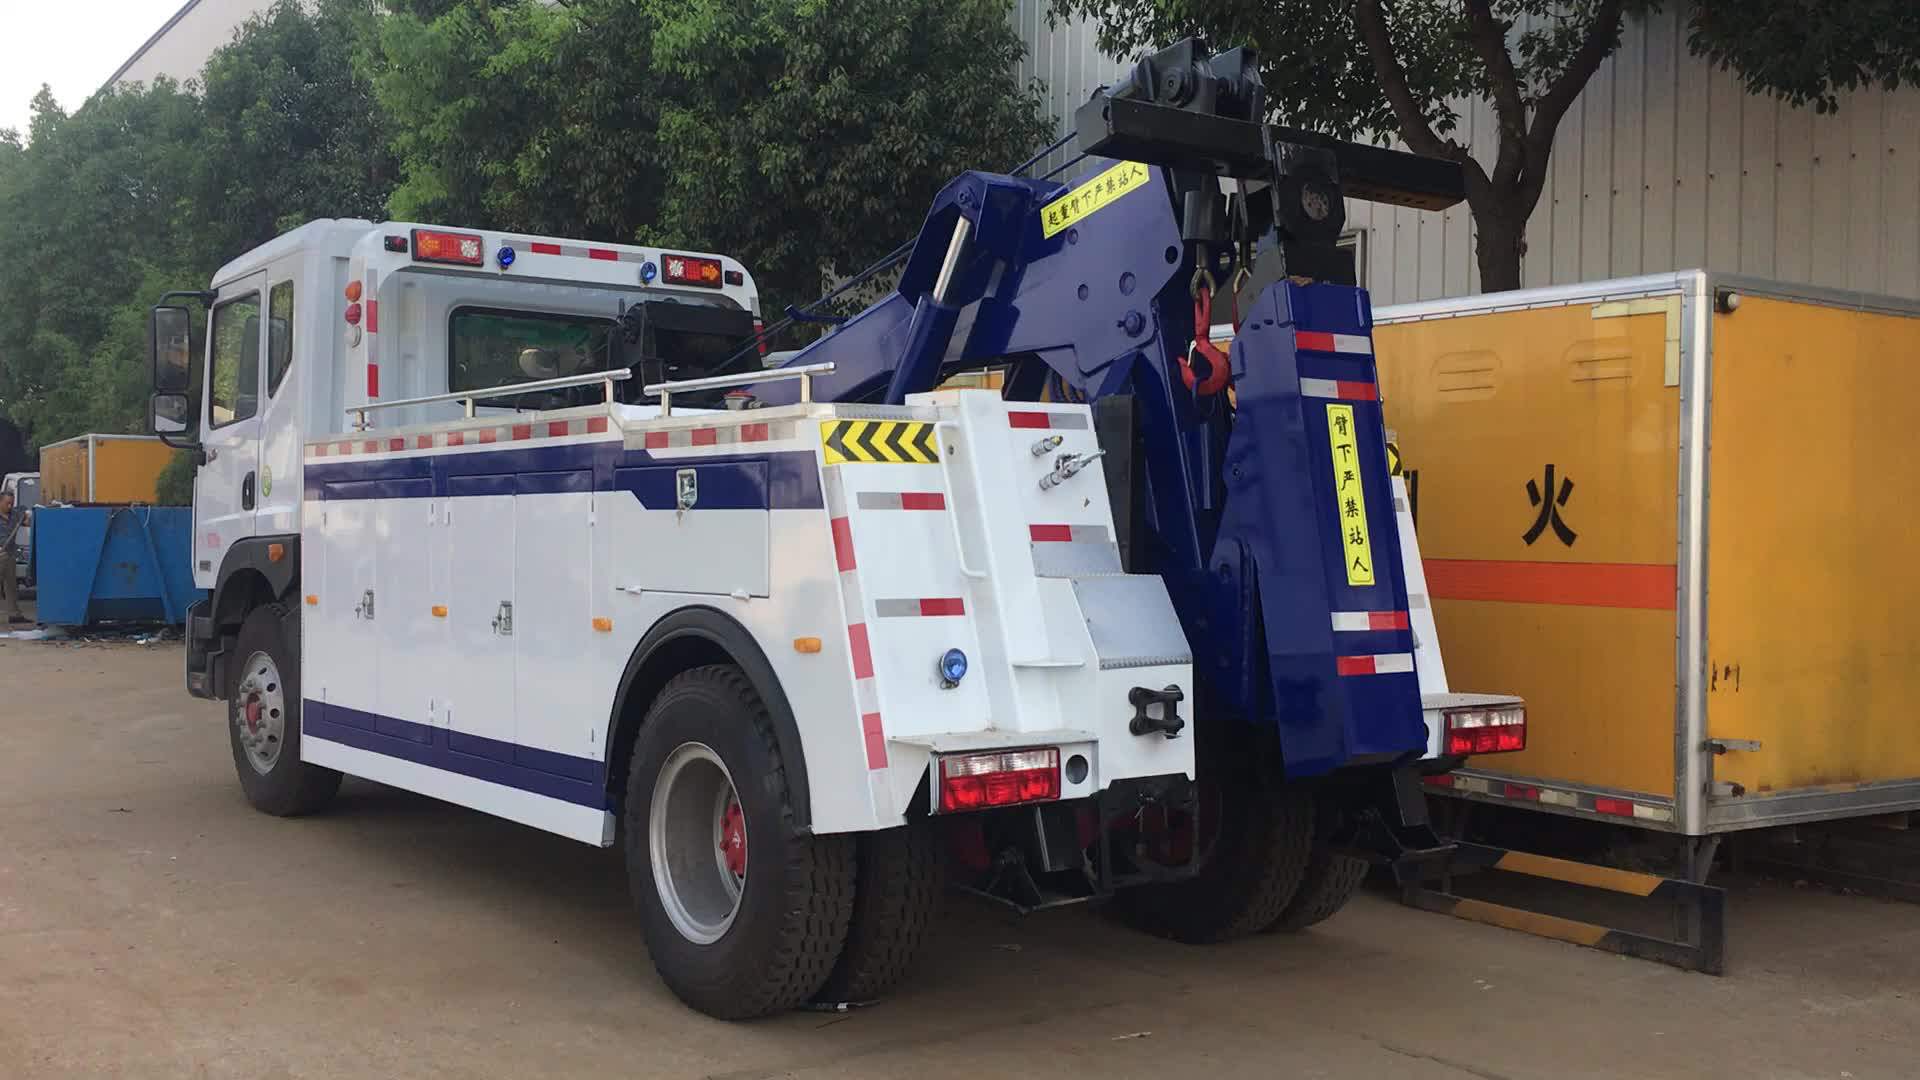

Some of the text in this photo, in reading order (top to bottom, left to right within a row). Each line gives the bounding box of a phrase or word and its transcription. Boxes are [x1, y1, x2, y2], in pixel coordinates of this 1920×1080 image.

[1048, 165, 1143, 225] 起重臂下严禁站人
[1334, 413, 1369, 572] 臂下严禁站人
